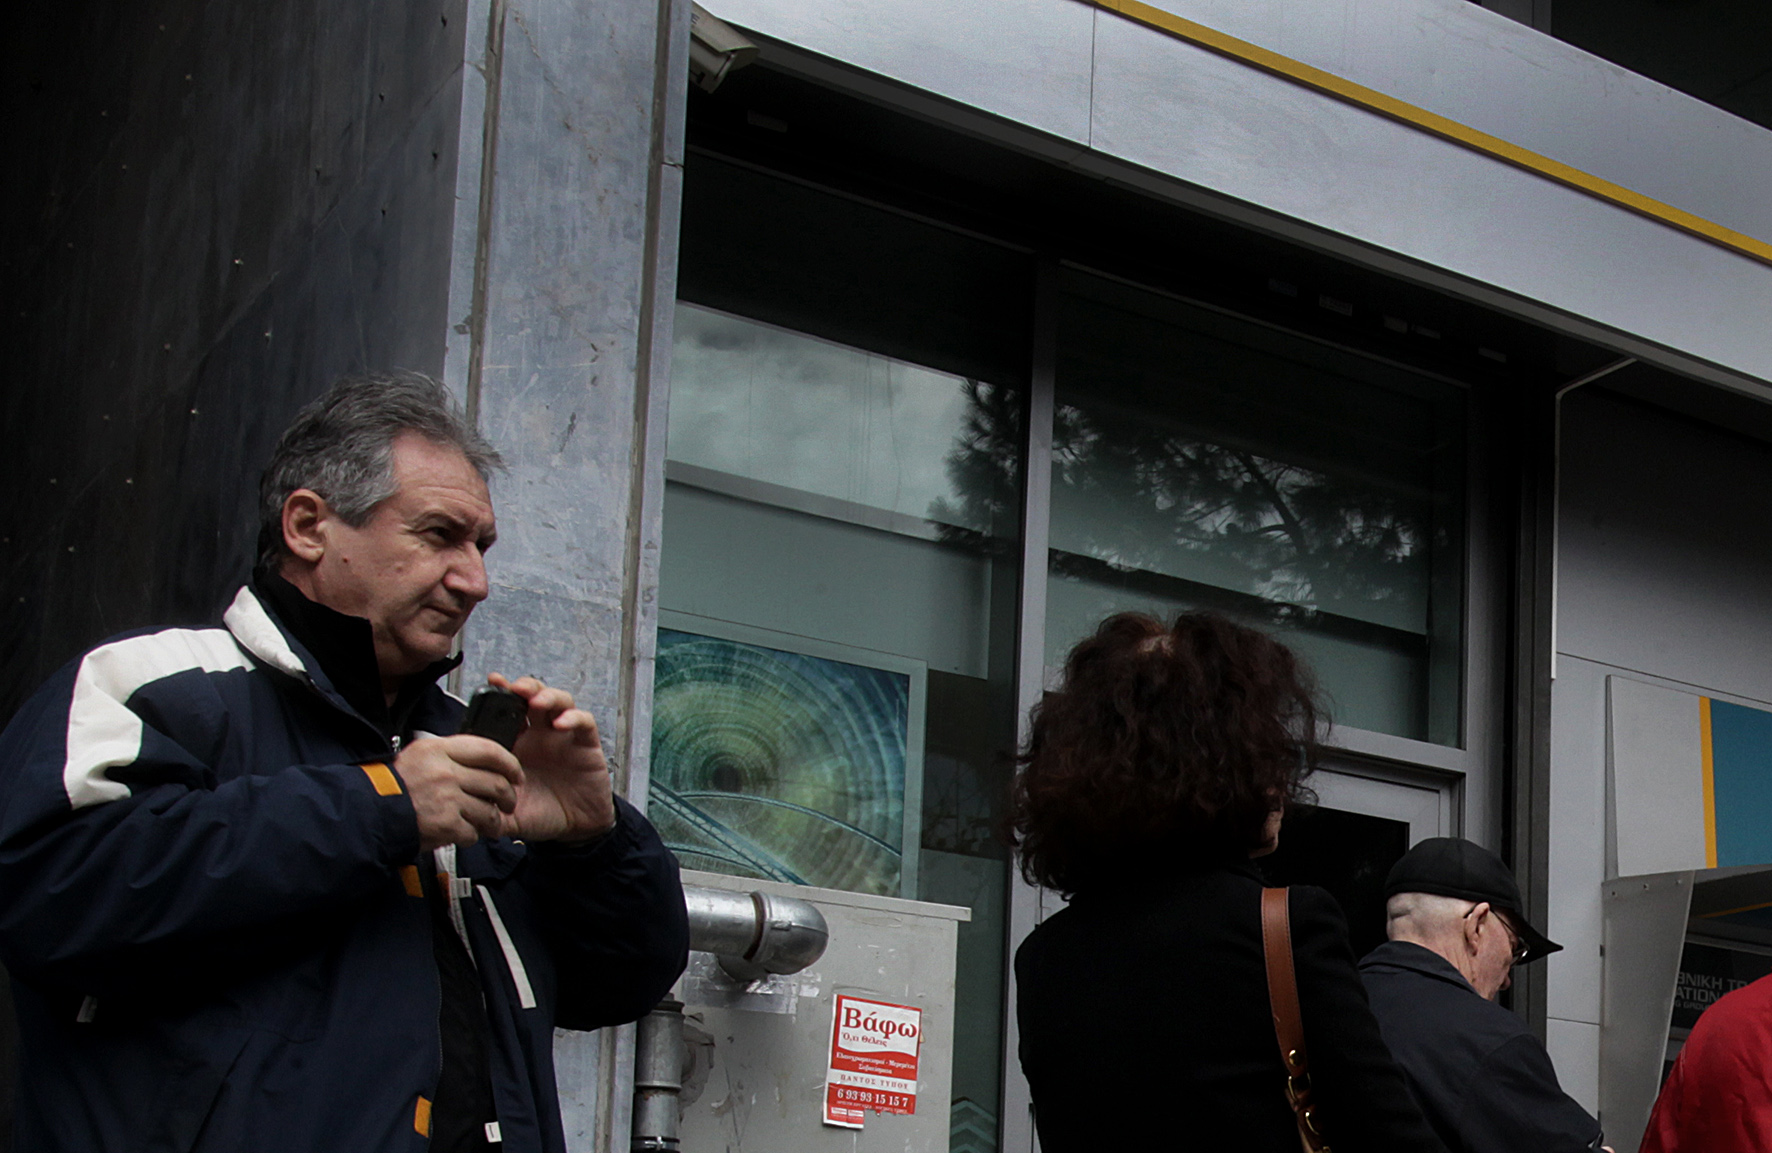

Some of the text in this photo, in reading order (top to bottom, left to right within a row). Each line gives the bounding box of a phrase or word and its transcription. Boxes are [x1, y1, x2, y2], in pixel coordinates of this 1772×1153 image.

[842, 1006, 917, 1040] Βάφω
[840, 1074, 909, 1090] ΠΑΝΤΟΣ ΤΥΠΟΥ
